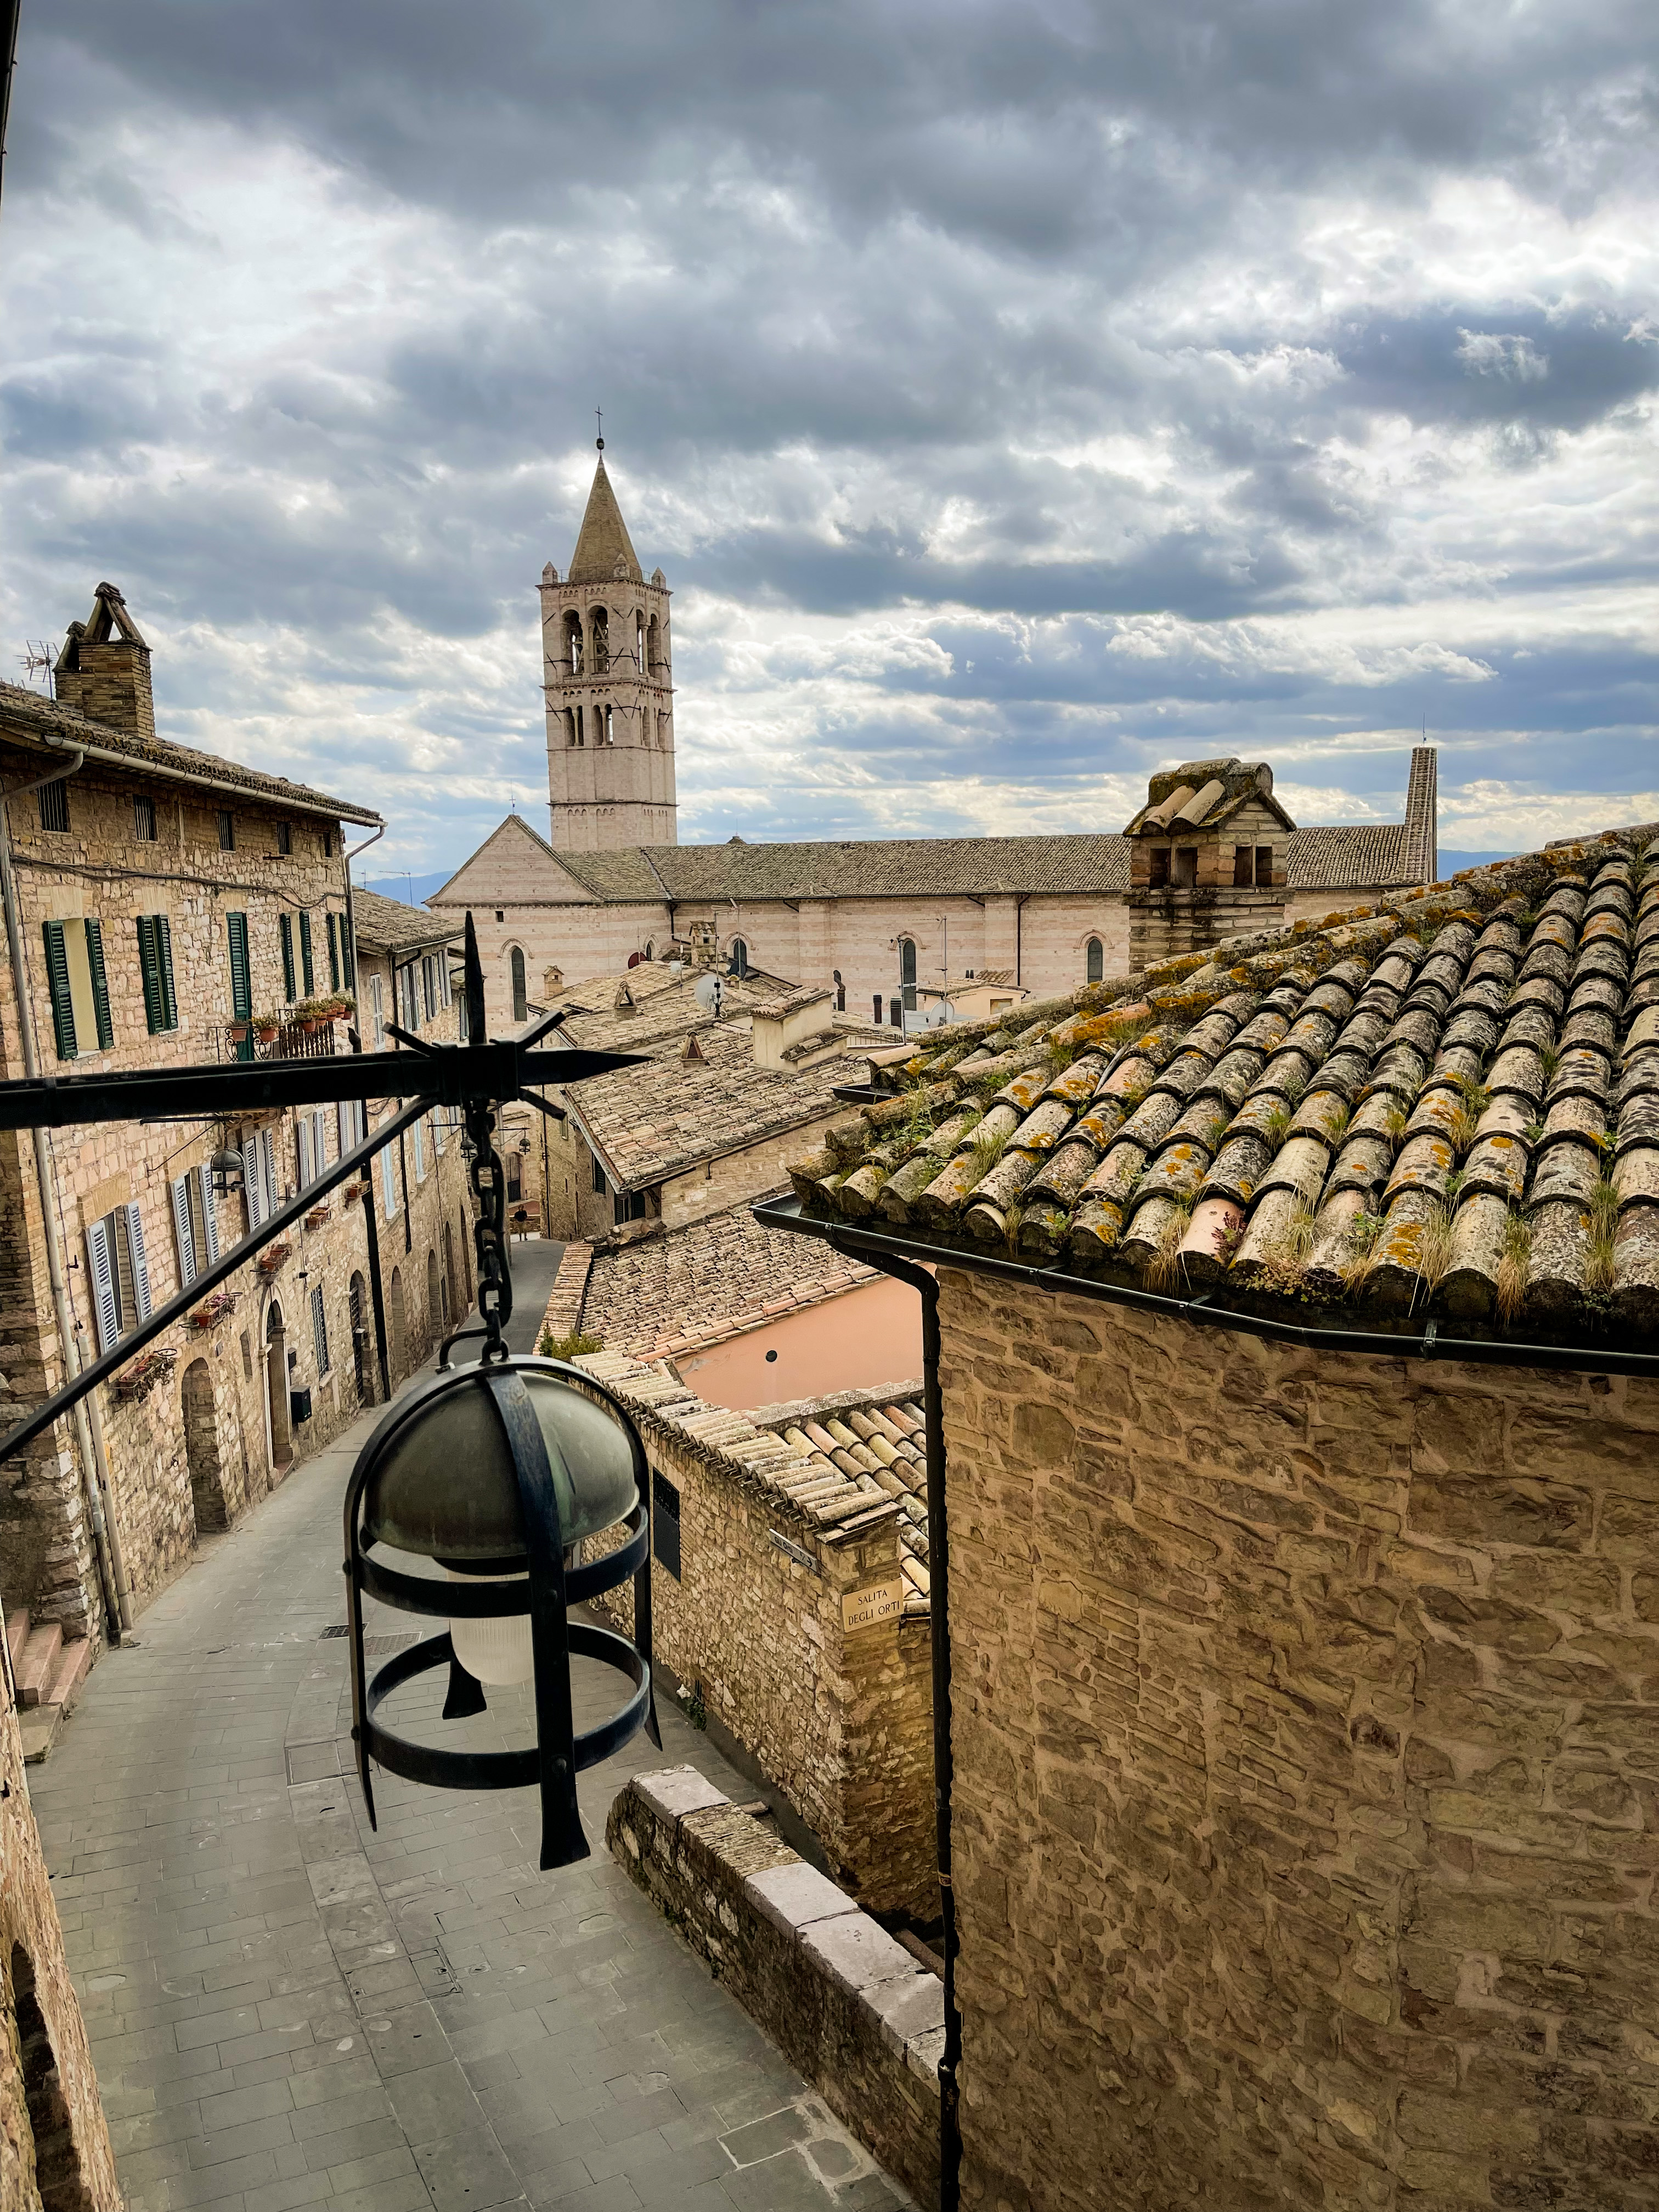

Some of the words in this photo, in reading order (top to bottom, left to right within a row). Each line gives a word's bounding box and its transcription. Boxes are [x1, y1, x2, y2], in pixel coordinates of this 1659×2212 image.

[858, 1589, 887, 1605] SALITA
[849, 1609, 873, 1626] DEGLI
[878, 1600, 900, 1615] ORTI
